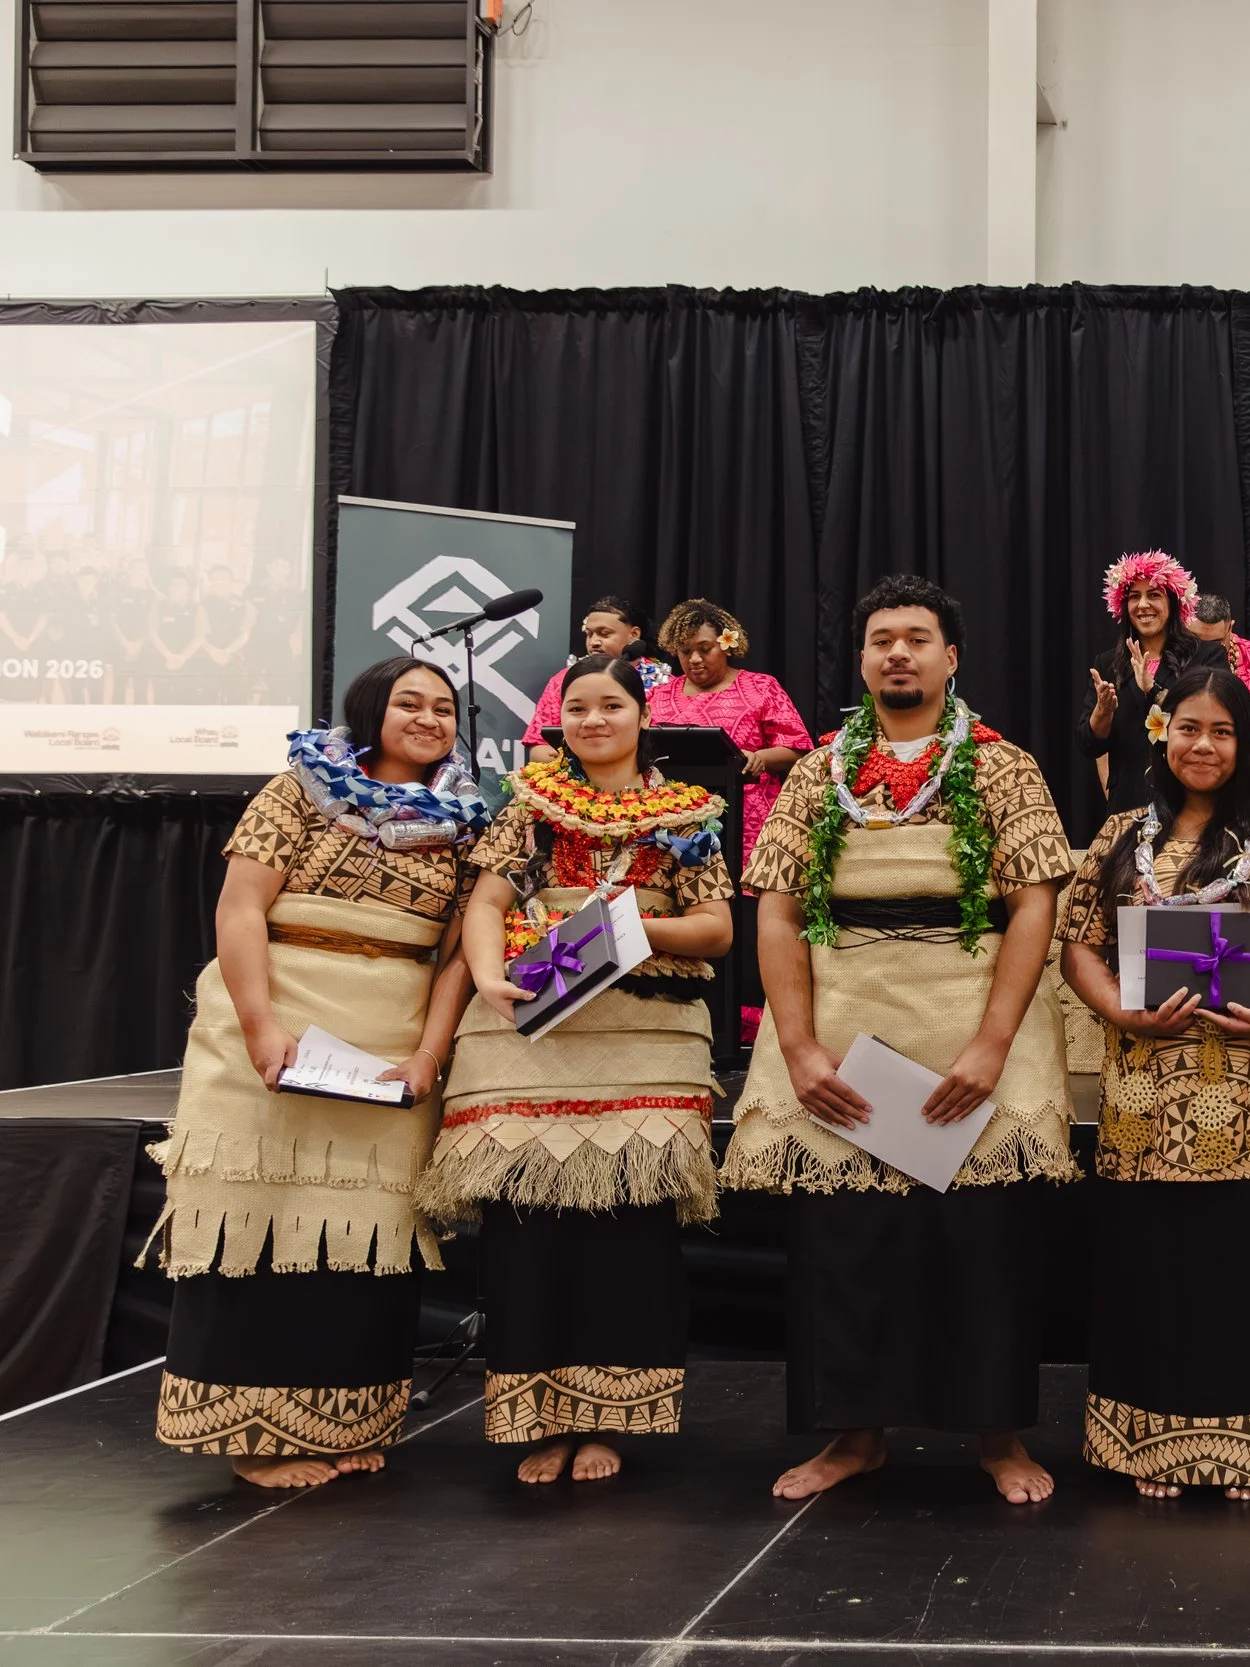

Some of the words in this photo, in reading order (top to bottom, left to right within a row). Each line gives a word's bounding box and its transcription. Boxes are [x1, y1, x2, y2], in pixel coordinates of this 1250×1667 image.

[46, 659, 104, 679] 2026
[48, 738, 72, 746] Local
[168, 735, 193, 743] Local
